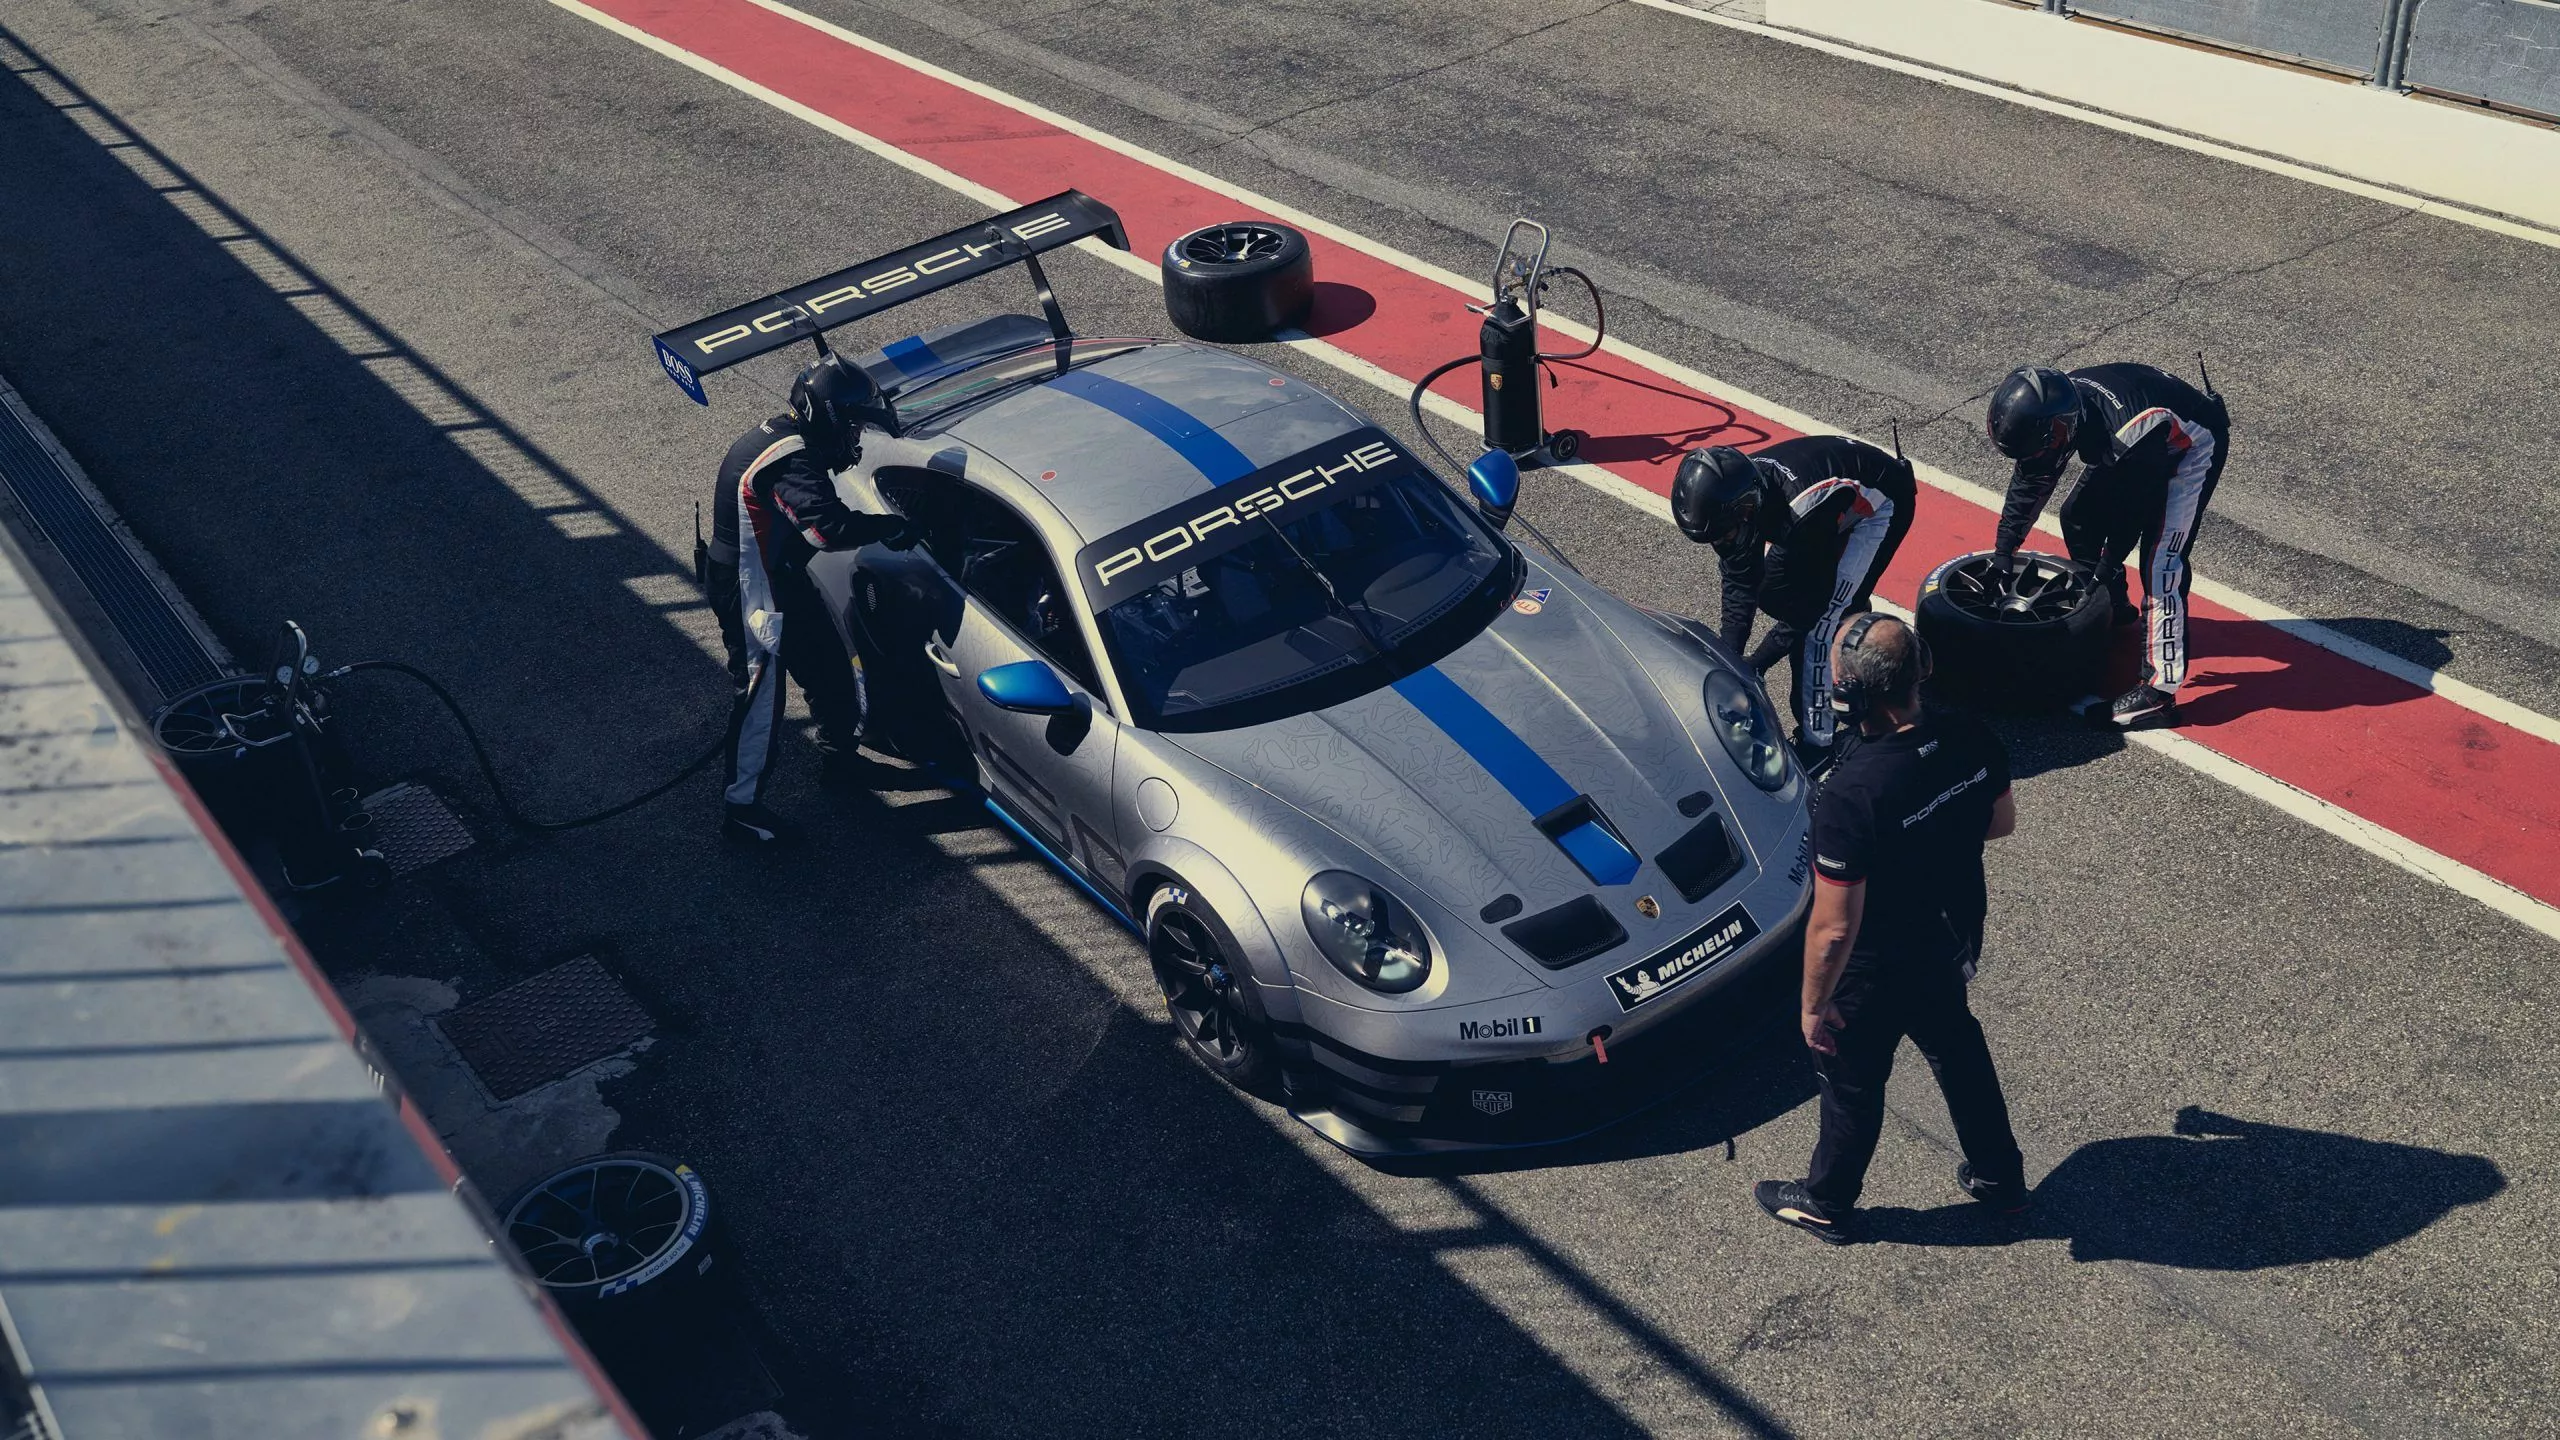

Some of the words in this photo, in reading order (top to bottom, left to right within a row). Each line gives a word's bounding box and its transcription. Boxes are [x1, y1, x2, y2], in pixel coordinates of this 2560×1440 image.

[694, 212, 1071, 354] PORSCHE
[661, 347, 693, 384] BOSS
[1095, 441, 1398, 587] PORSCHE
[2162, 531, 2185, 684] PORSCHE
[1813, 579, 1854, 731] PORSCHE
[1902, 767, 1988, 828] PORSCHE
[1788, 844, 1808, 887] Mobil
[1657, 919, 1744, 981] MICHELIN
[1459, 1018, 1519, 1040] Mobil
[1525, 1017, 1538, 1034] 1
[1475, 1092, 1509, 1100] TAG
[1475, 1101, 1510, 1113] HEUER
[687, 1181, 706, 1236] MICHELIN
